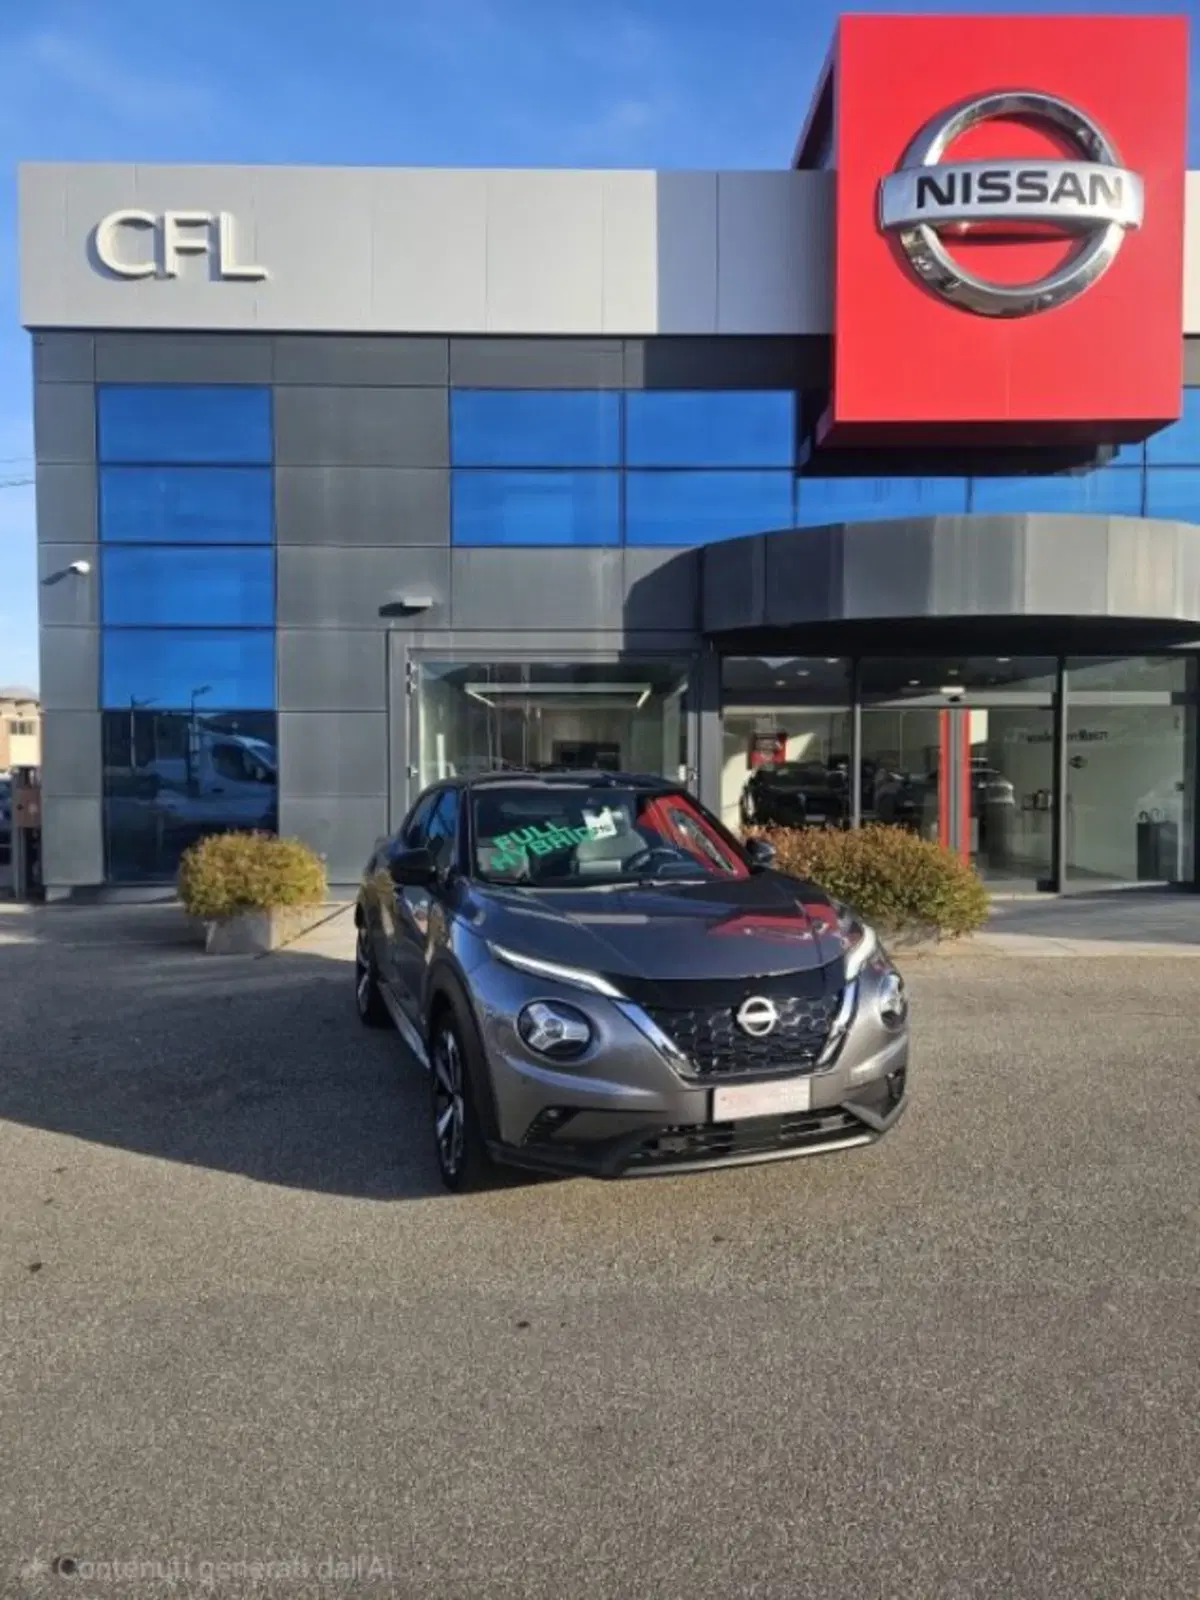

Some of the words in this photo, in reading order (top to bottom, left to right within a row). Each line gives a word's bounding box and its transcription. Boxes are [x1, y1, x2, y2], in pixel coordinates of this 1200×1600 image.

[917, 169, 1123, 209] NISSAN
[92, 209, 268, 280] CFL
[491, 820, 568, 851] FULL
